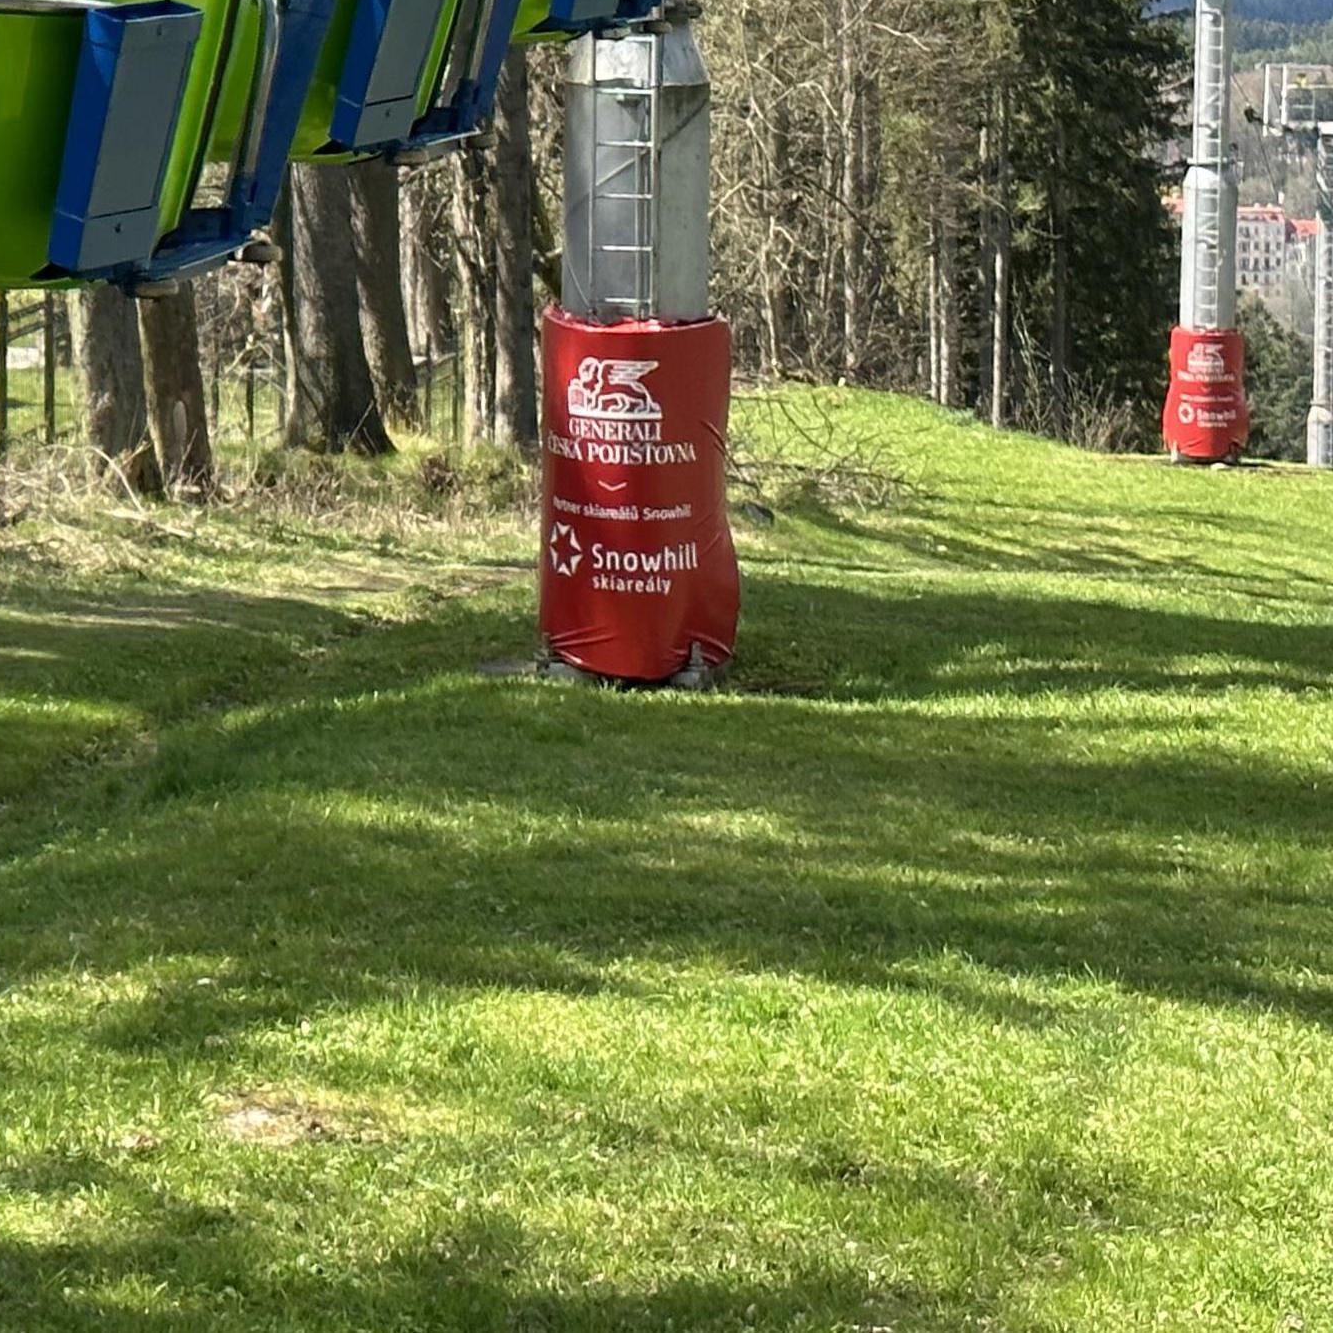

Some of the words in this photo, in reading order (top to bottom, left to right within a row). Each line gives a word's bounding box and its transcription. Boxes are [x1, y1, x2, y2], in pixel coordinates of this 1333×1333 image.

[568, 417, 662, 441] GENERALI
[592, 542, 698, 572] Snowhill
[593, 574, 672, 596] skiareály
